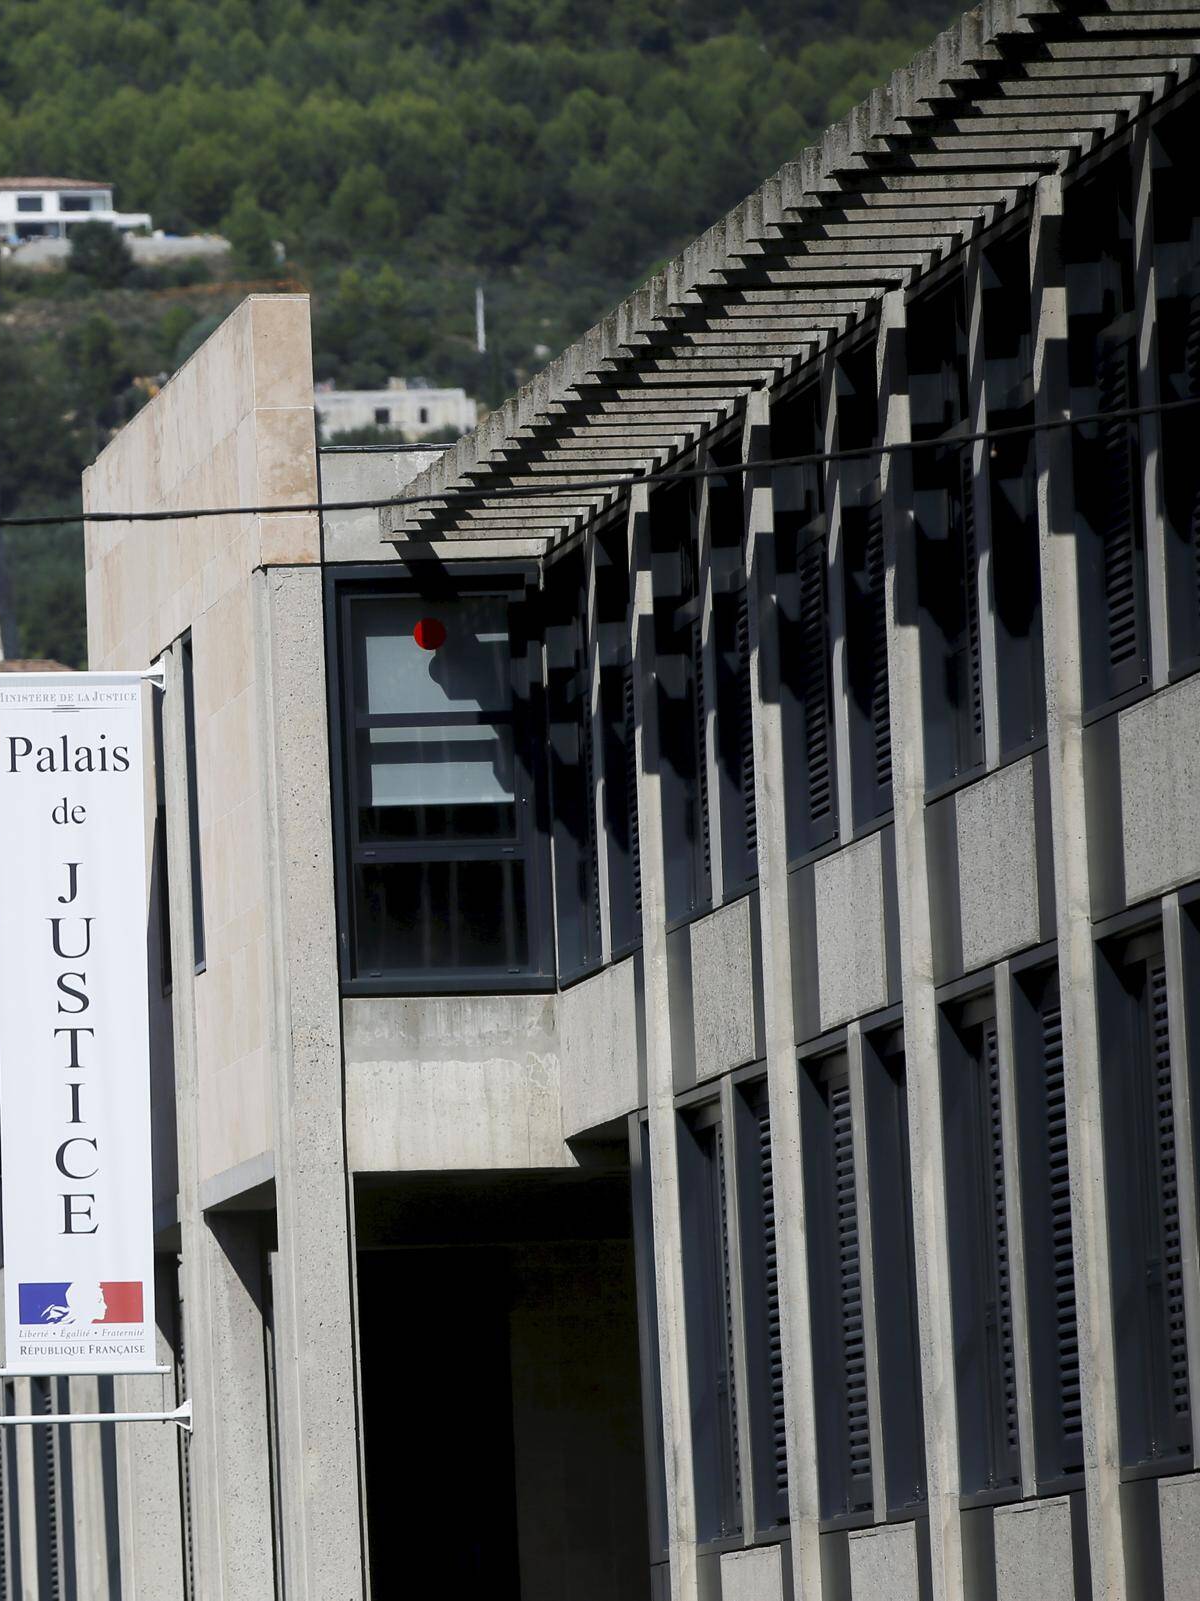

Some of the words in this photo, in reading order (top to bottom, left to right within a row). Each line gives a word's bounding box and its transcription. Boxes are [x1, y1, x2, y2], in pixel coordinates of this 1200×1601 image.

[60, 692, 74, 702] DE
[77, 691, 91, 701] LA
[92, 690, 137, 701] JUSTICE
[6, 734, 130, 773] Palais
[52, 797, 86, 824] de
[45, 862, 99, 1235] JUSTICE
[18, 1330, 49, 1338] Liberté
[60, 1328, 90, 1339] Égalité
[101, 1327, 145, 1337] Fraternité
[20, 1345, 85, 1356] RÉPUBLIQUE
[89, 1344, 145, 1355] FRANÇAISE
